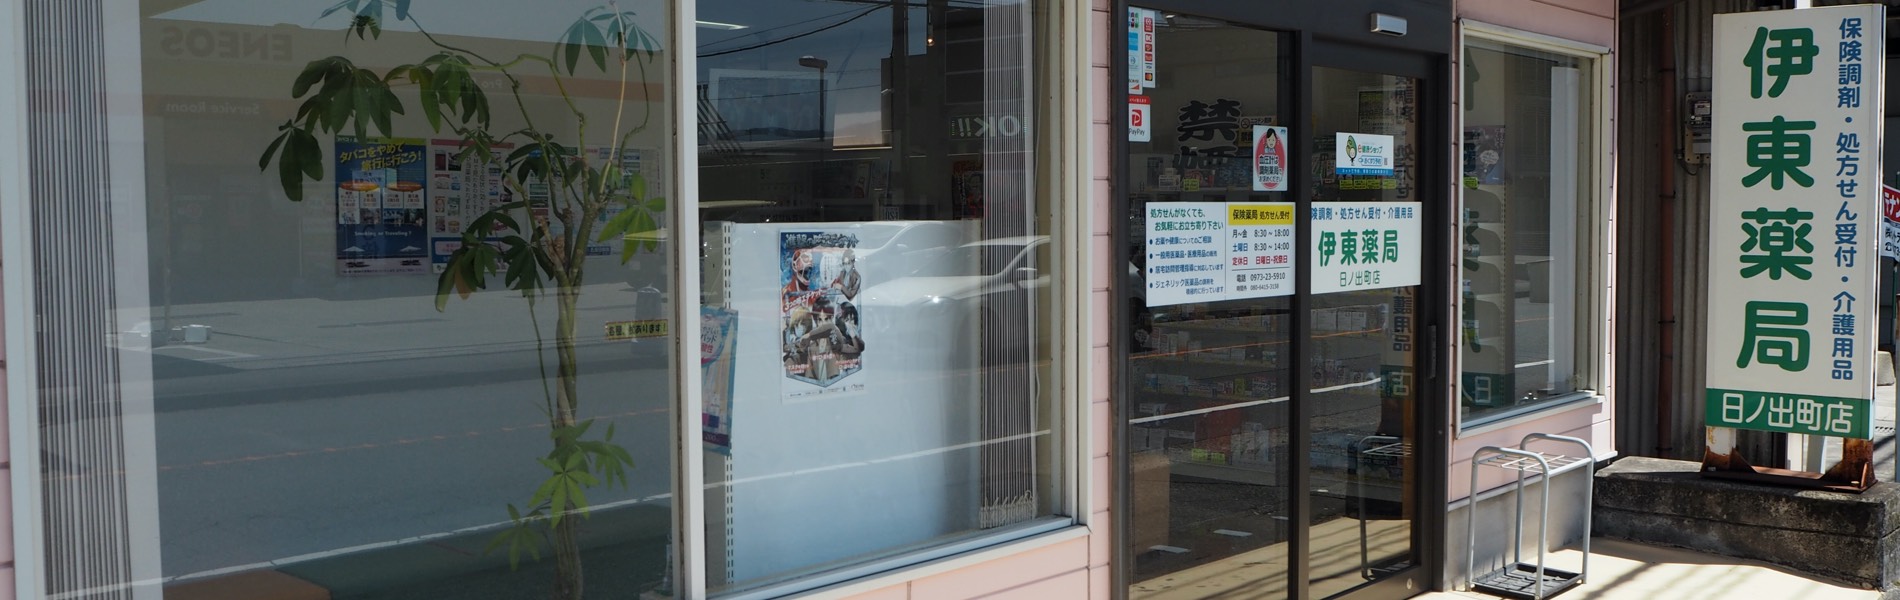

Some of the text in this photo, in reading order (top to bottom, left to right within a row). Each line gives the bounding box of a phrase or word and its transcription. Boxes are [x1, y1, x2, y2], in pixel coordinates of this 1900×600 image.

[1129, 127, 1145, 136] PayPay
[340, 143, 405, 163] タバコをやめて
[1259, 155, 1279, 164] 血圧計は
[1736, 26, 1820, 372] 伊東薬局
[1832, 17, 1862, 380] 保険調剤・処方せん受付・介護用品
[1150, 208, 1206, 218] 処方せんがなくても、
[1232, 209, 1290, 220] 保険薬局 処方せん受付
[1154, 221, 1224, 231] お気軽にお立ち寄り下さい
[1254, 229, 1267, 237] 8:30
[1274, 229, 1290, 237] 18:00
[1232, 243, 1248, 252] 土曜日
[1254, 243, 1267, 251] 8:30
[1274, 242, 1290, 251] 14:00
[1318, 228, 1399, 267] 伊東薬局
[1232, 255, 1288, 266] 定休日 日曜日・祝祭日
[1250, 272, 1285, 281] 0973-23-5910
[1339, 270, 1381, 287] 日ノ出町店
[1722, 391, 1854, 434] 日ノ出町店
